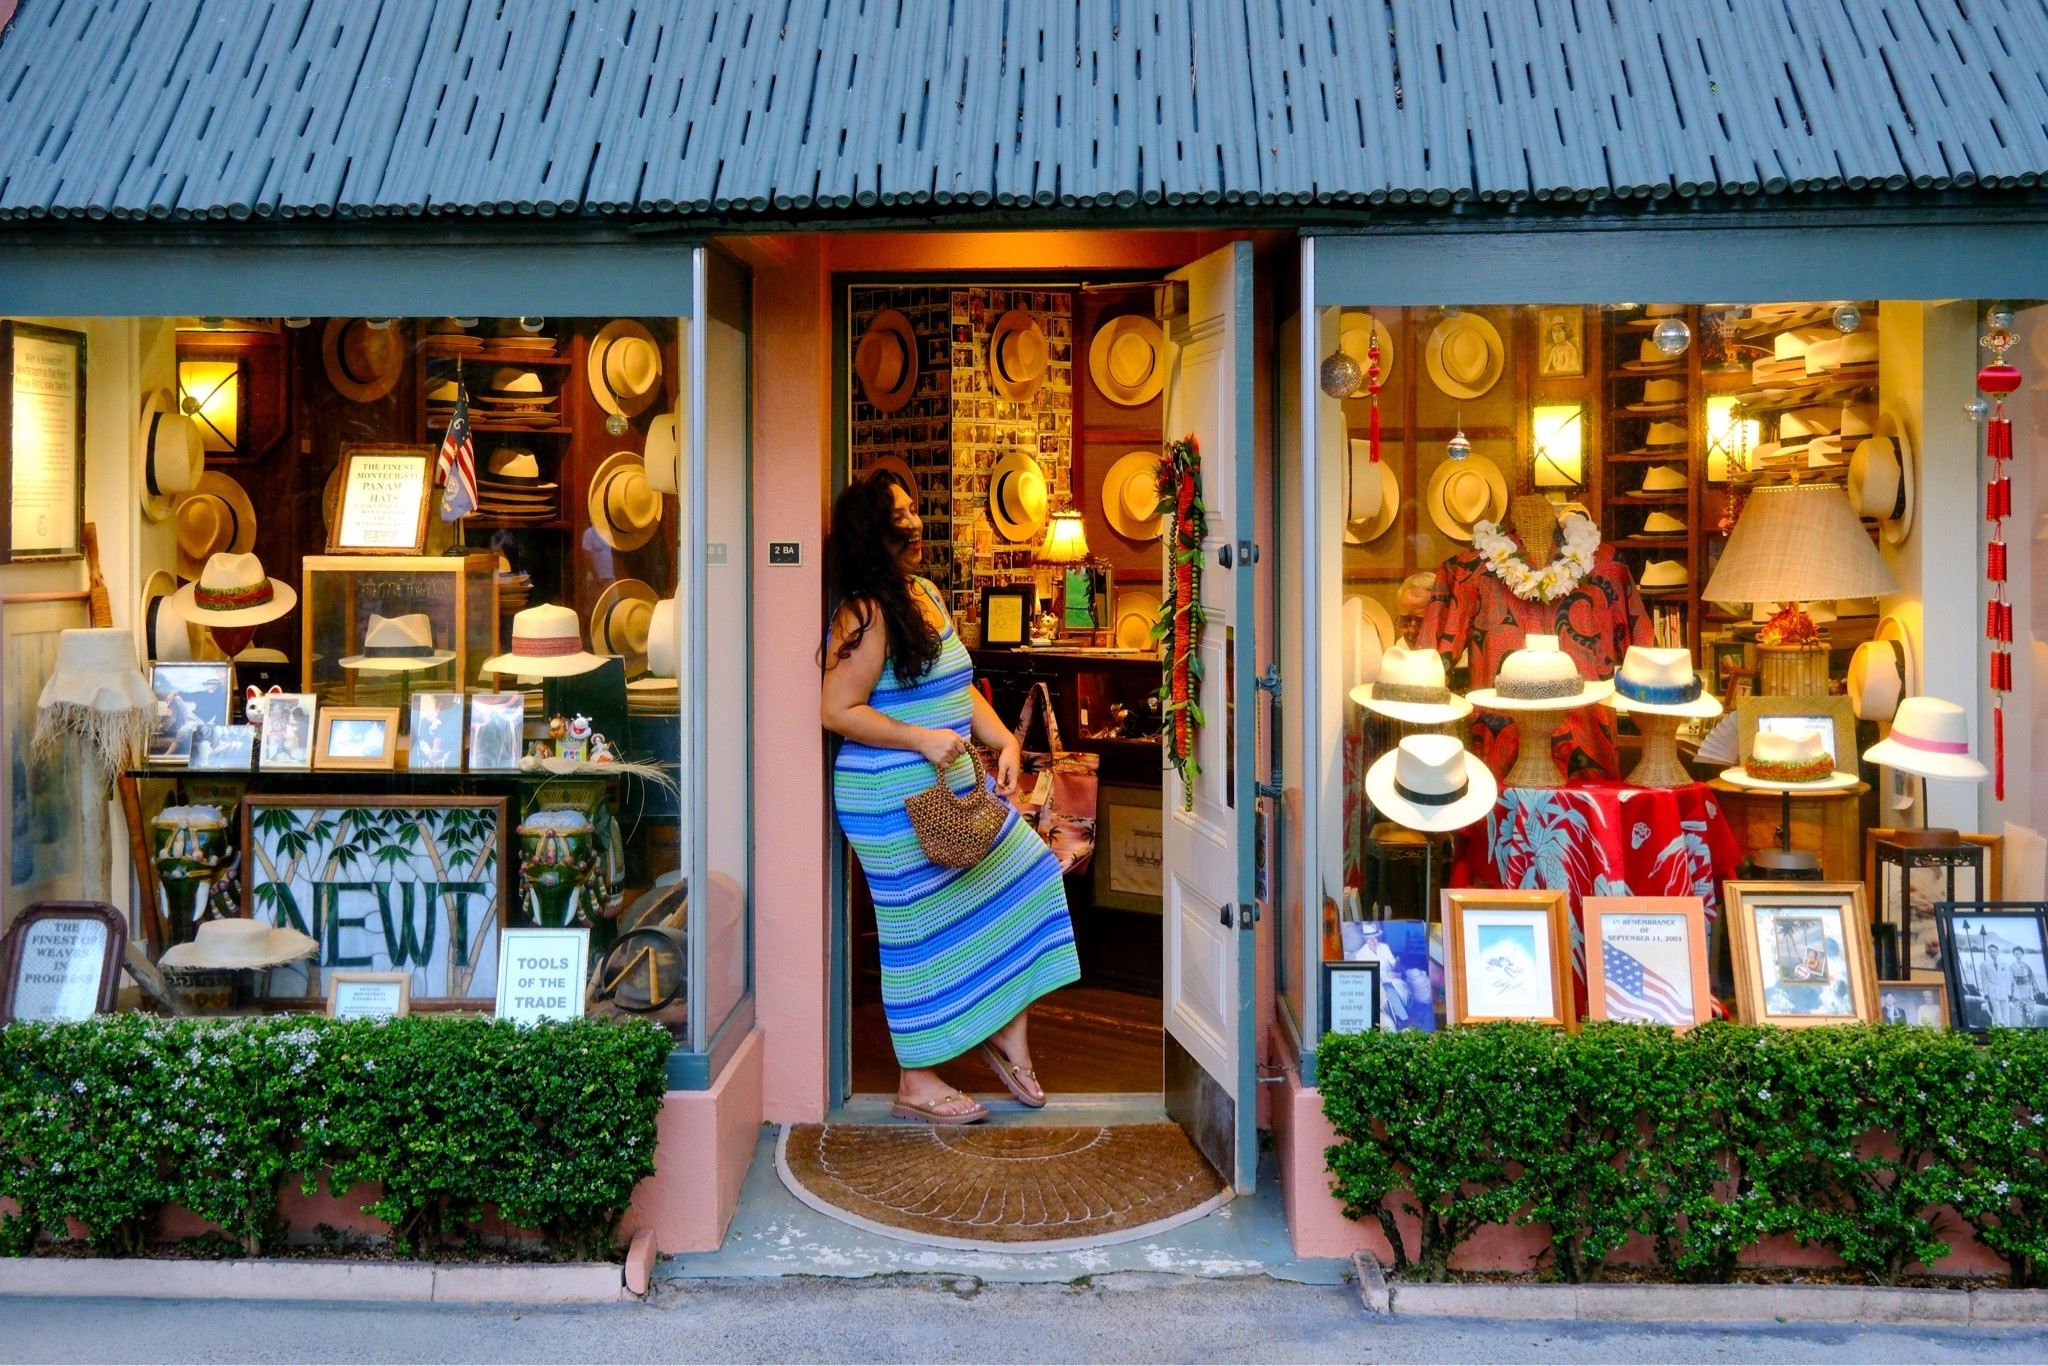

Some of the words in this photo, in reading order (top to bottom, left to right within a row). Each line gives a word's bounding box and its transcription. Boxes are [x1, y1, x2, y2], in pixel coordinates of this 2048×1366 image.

[357, 472, 418, 480] MONTECRISTI
[362, 482, 402, 491] PANAM
[370, 494, 399, 502] HATS
[774, 546, 780, 554] 2
[783, 546, 794, 554] BA
[55, 923, 79, 932] THE
[275, 882, 486, 967] NEWT
[32, 935, 78, 945] FINEST
[82, 935, 98, 945] OF
[37, 948, 89, 958] WEAVES
[54, 961, 67, 970] IN
[517, 958, 569, 970] TOOLS
[518, 978, 535, 988] OF
[539, 978, 565, 988] THE
[515, 997, 566, 1008] TRADE
